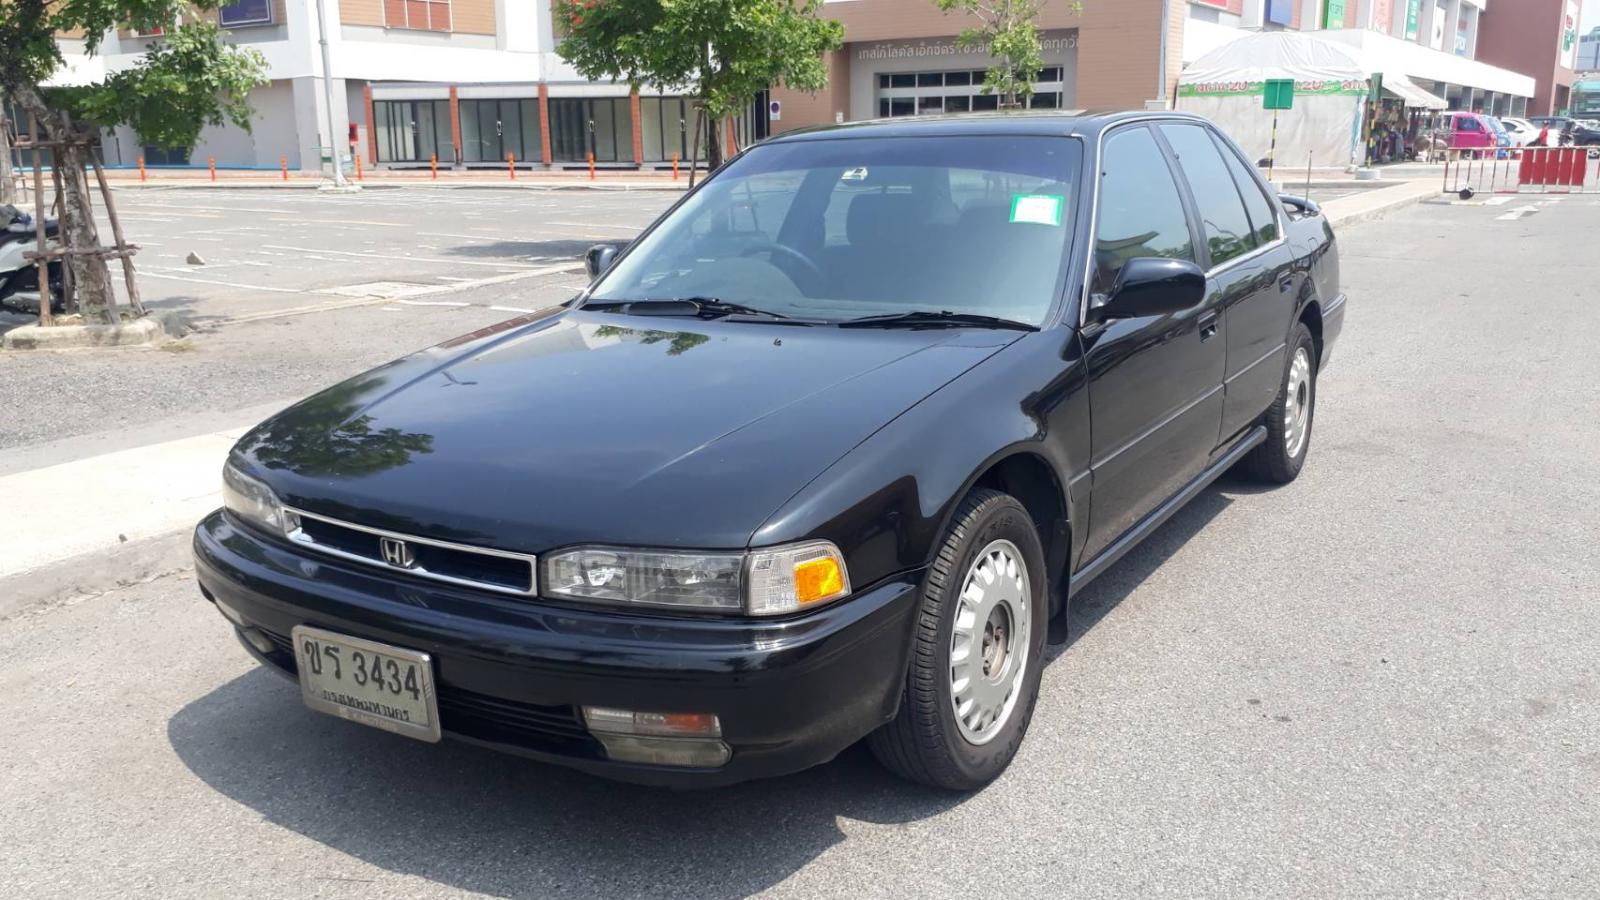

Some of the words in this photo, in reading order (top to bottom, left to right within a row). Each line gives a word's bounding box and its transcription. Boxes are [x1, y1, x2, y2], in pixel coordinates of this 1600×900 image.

[352, 651, 420, 700] 3434
[322, 690, 409, 721] กรงเทพมหานคร
